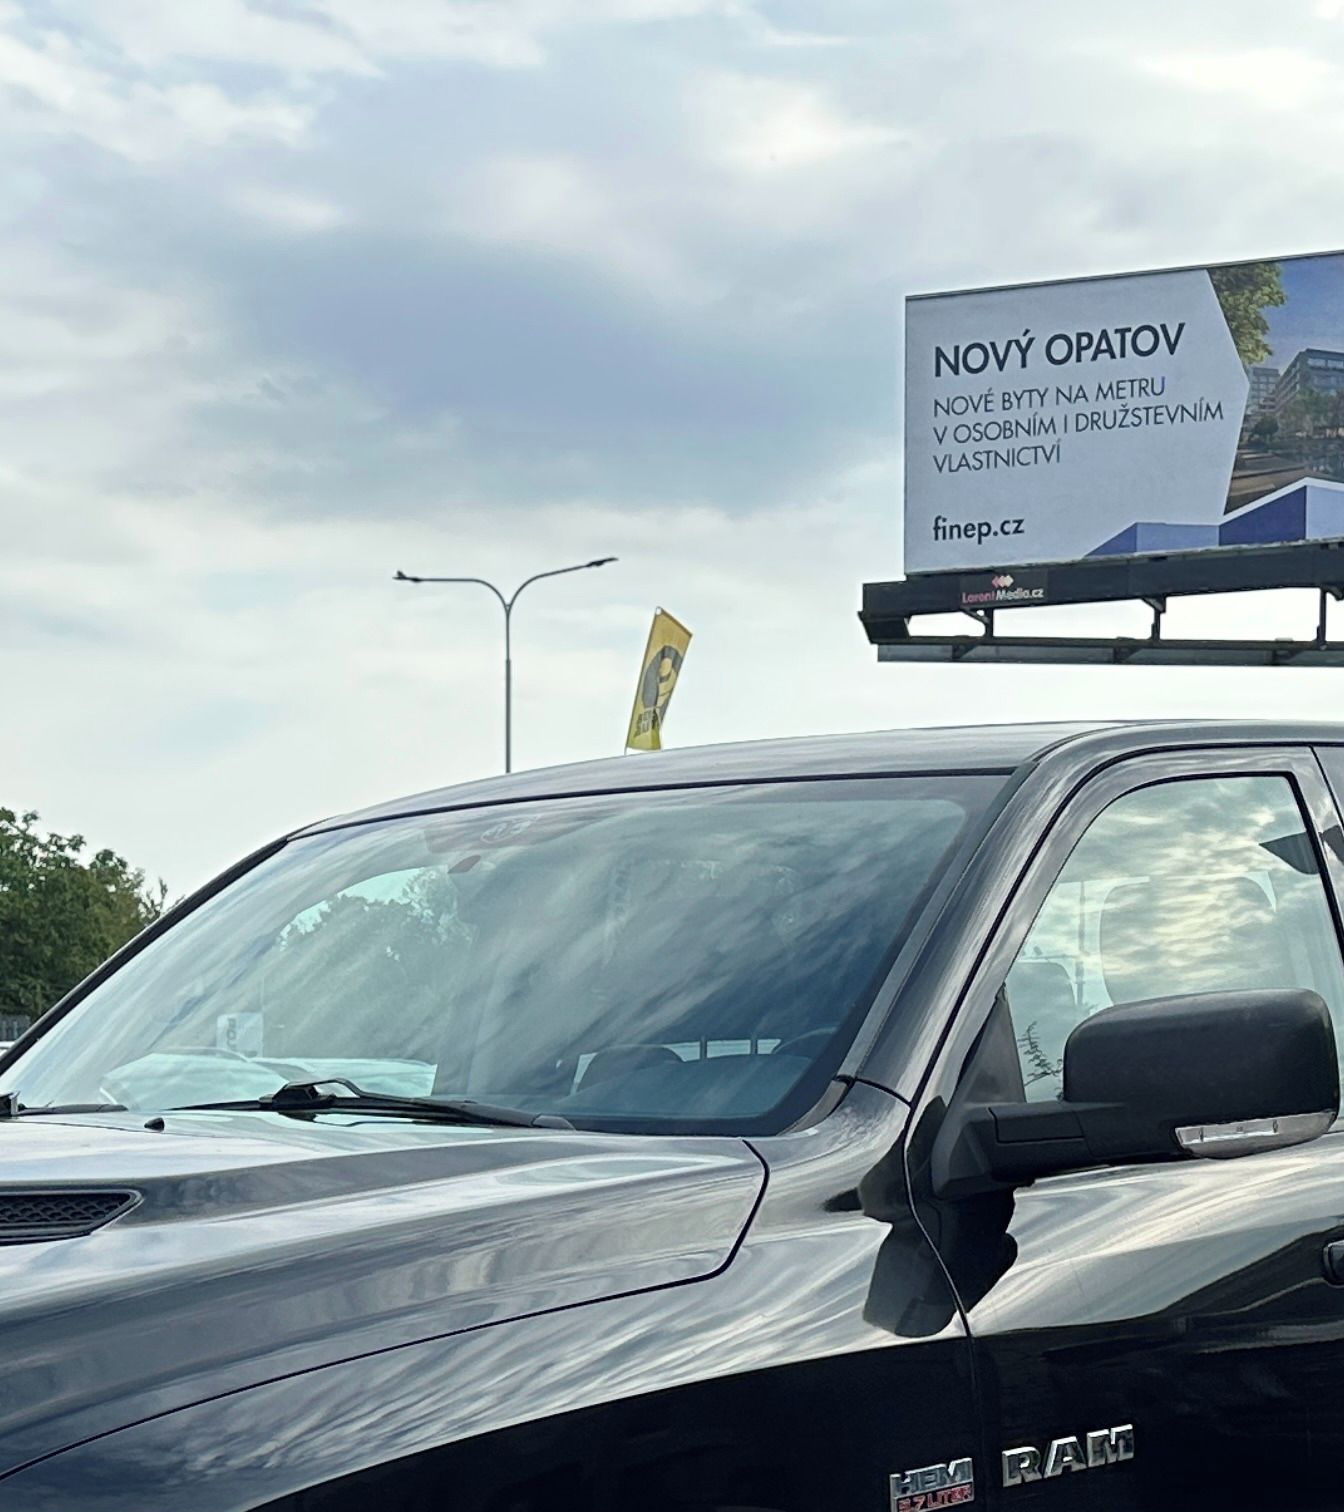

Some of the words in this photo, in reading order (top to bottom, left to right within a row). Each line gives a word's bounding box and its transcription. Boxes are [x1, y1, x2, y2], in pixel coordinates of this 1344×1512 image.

[934, 328, 1036, 377] NOVÝ
[1045, 322, 1186, 366] OPATOV
[933, 387, 995, 418] NOVÉ
[1001, 387, 1049, 411] BYTY
[1056, 384, 1089, 405] NA
[1096, 376, 1166, 401] METRU
[932, 425, 948, 445] V
[953, 411, 1056, 444] OSOBNÍM
[1063, 417, 1068, 433] I
[1075, 397, 1224, 433] DRUŽSTEVNÍM
[932, 438, 1061, 474] VLASTNICTVÍ
[932, 514, 1025, 545] finep.cz
[1001, 1423, 1135, 1487] RAM
[889, 1457, 973, 1499] HEMI
